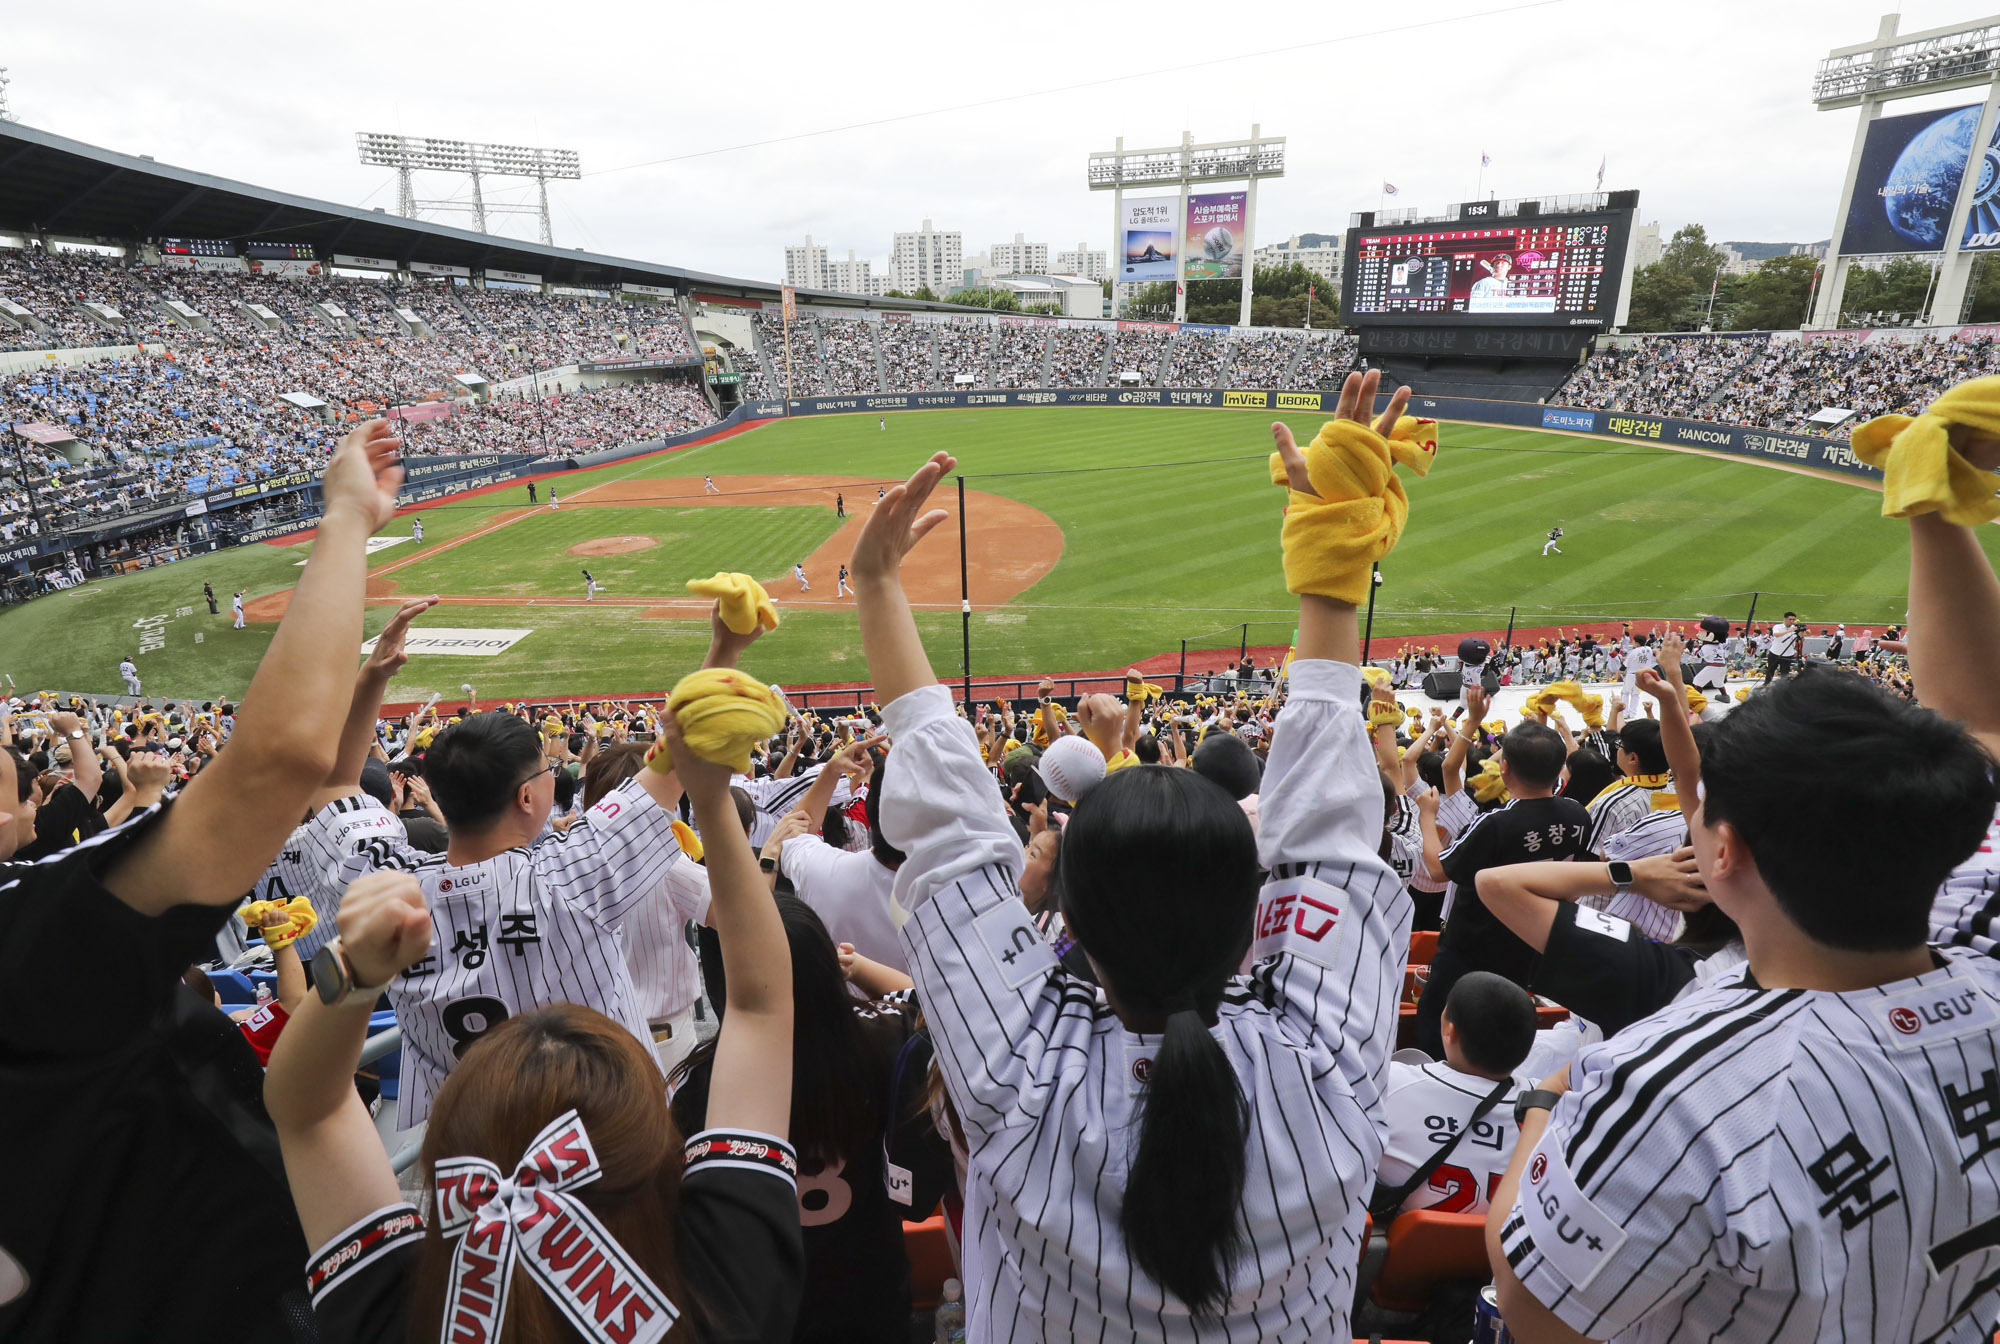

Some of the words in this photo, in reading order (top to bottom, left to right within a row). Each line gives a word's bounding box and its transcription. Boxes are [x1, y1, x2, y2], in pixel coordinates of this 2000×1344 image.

[1878, 184, 1908, 197] 내일의
[1133, 207, 1154, 216] 압도적
[1156, 206, 1168, 215] 1위
[1468, 206, 1488, 216] 15:54
[1194, 215, 1214, 223] 스포키
[1216, 214, 1238, 223] 앱에서
[1368, 331, 1457, 348] 한국경제신문
[917, 396, 956, 404] 한국경제신문
[1132, 391, 1161, 403] 금강주택
[1170, 391, 1213, 405] 현대해상
[1277, 395, 1320, 407] UBORA
[1551, 414, 1593, 429] 도미노피자
[1608, 418, 1663, 439] 대방건설
[1677, 427, 1731, 446] HANCOM
[1764, 436, 1811, 459] 대보건설
[409, 466, 432, 477] 공공기관
[208, 491, 232, 502] mentos
[1523, 823, 1585, 852] 홍창기
[455, 877, 470, 888] LG
[471, 871, 487, 886] U+
[1919, 1002, 1951, 1026] LG
[1951, 986, 1978, 1017] U+
[889, 1177, 910, 1191] U+
[1536, 1184, 1561, 1222] LG
[1555, 1214, 1604, 1254] U+
[518, 1189, 655, 1344] TWINS
